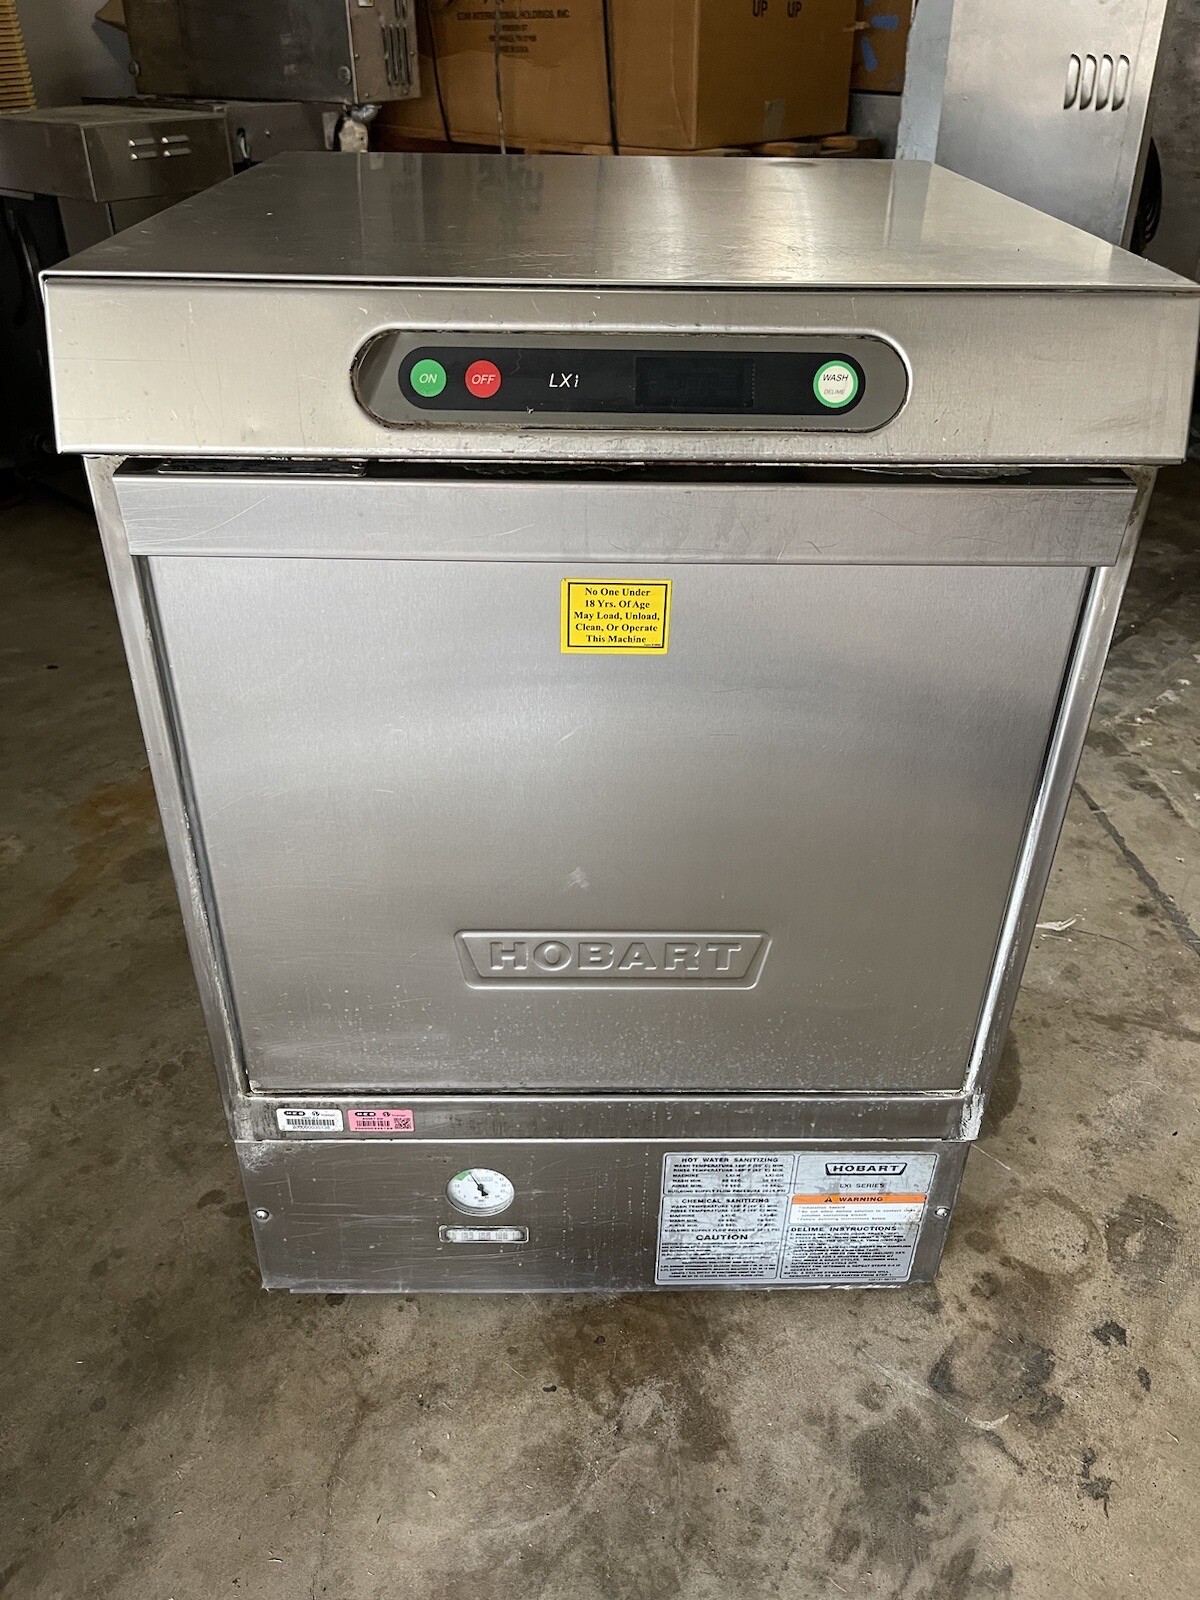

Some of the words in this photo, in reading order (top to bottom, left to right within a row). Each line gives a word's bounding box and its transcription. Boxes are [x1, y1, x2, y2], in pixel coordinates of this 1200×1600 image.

[753, 0, 768, 17] UP
[788, 0, 802, 18] UP
[419, 373, 438, 384] ON
[471, 374, 496, 385] OFF
[549, 373, 579, 388] LXi
[823, 374, 849, 382] WASH
[585, 587, 598, 596] No
[600, 587, 620, 596] One
[622, 588, 651, 596] Under
[585, 600, 595, 608] 18
[597, 600, 616, 608] Yrs.
[618, 600, 631, 608] Of
[632, 600, 651, 610] Age
[573, 611, 594, 621] May
[597, 611, 623, 621] Load,
[625, 612, 660, 621] Unload,
[575, 623, 604, 632] Clean,
[606, 623, 619, 632] Or
[621, 623, 658, 633] Operate
[586, 635, 605, 643] This
[608, 635, 647, 643] Machine
[489, 940, 742, 972] HOBART
[832, 1164, 900, 1172] HOBART
